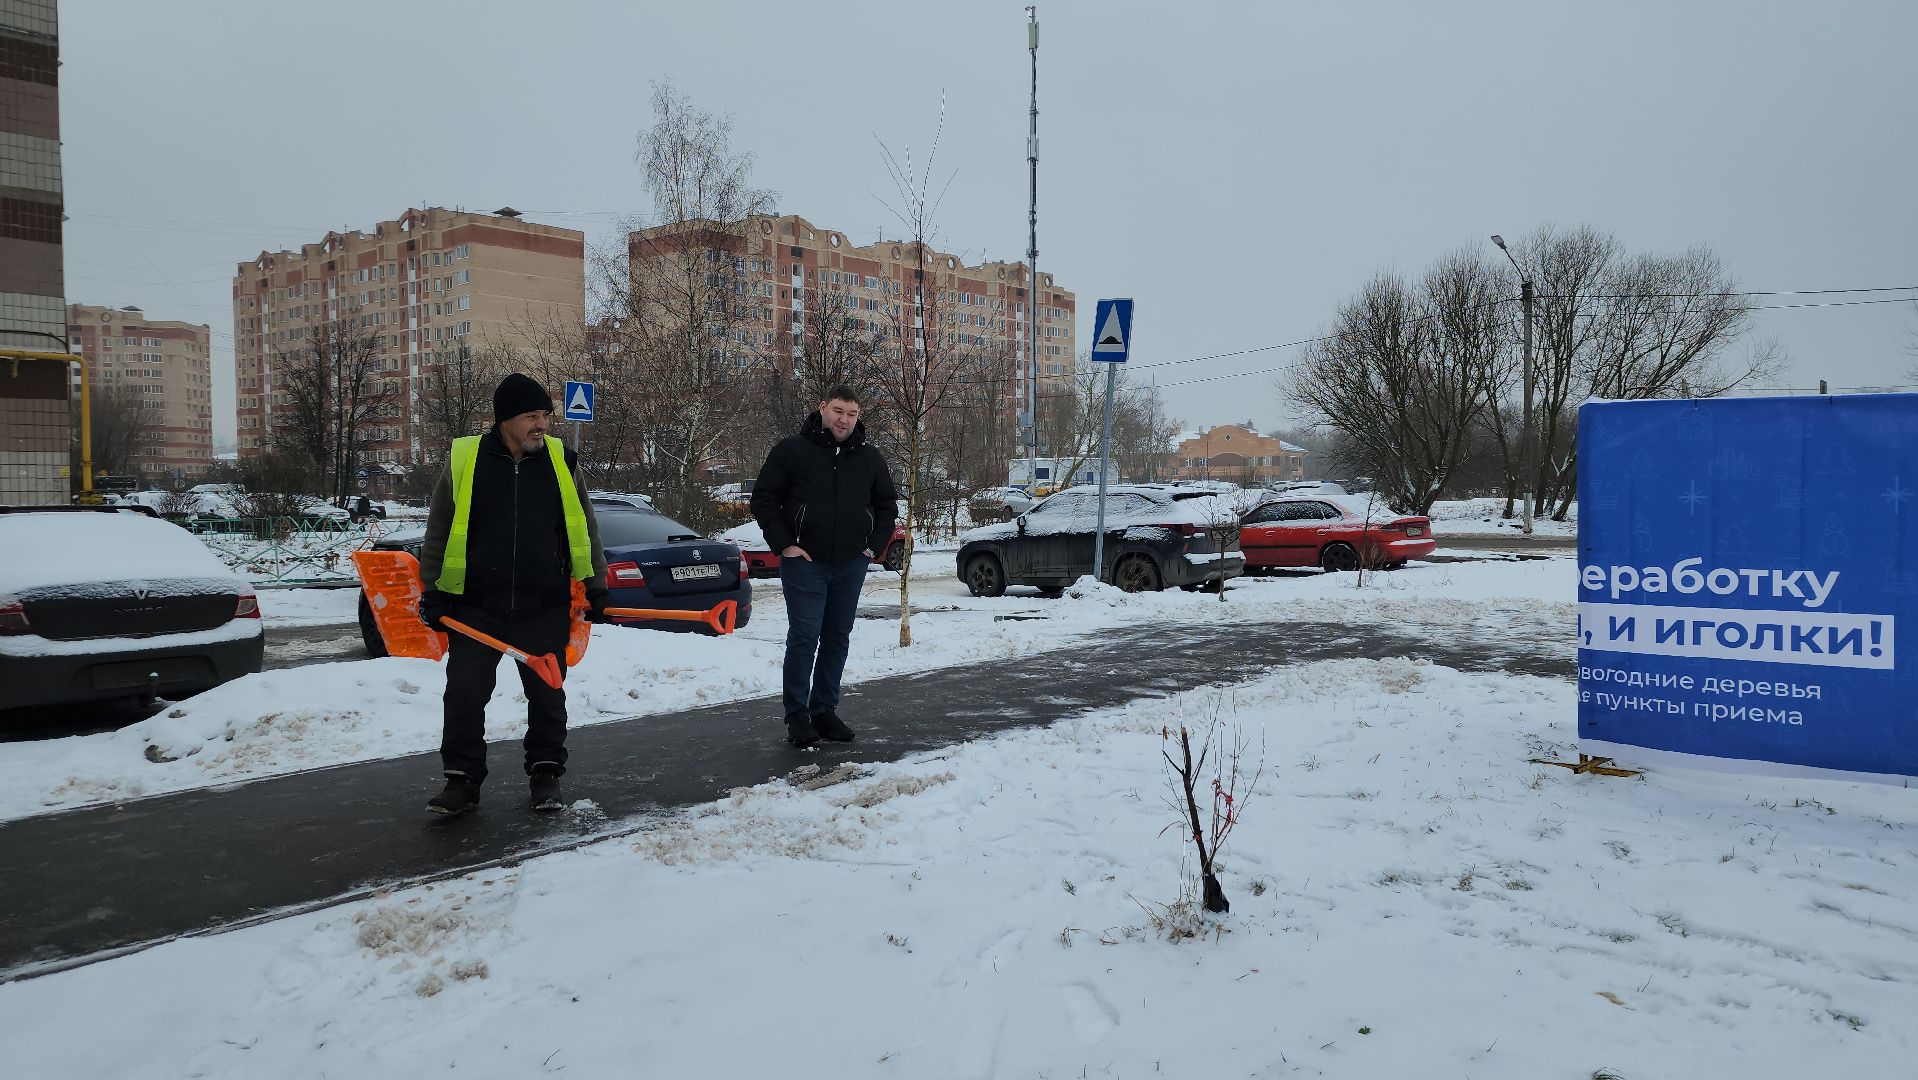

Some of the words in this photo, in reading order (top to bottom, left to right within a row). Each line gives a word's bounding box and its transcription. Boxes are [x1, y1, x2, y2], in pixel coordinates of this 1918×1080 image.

[1609, 616, 1636, 642] и
[1655, 618, 1883, 658] иголки!
[1578, 666, 1695, 690] вогодние
[1701, 677, 1821, 700] деревья
[1596, 692, 1685, 715] пункты
[1694, 703, 1803, 726] приема
